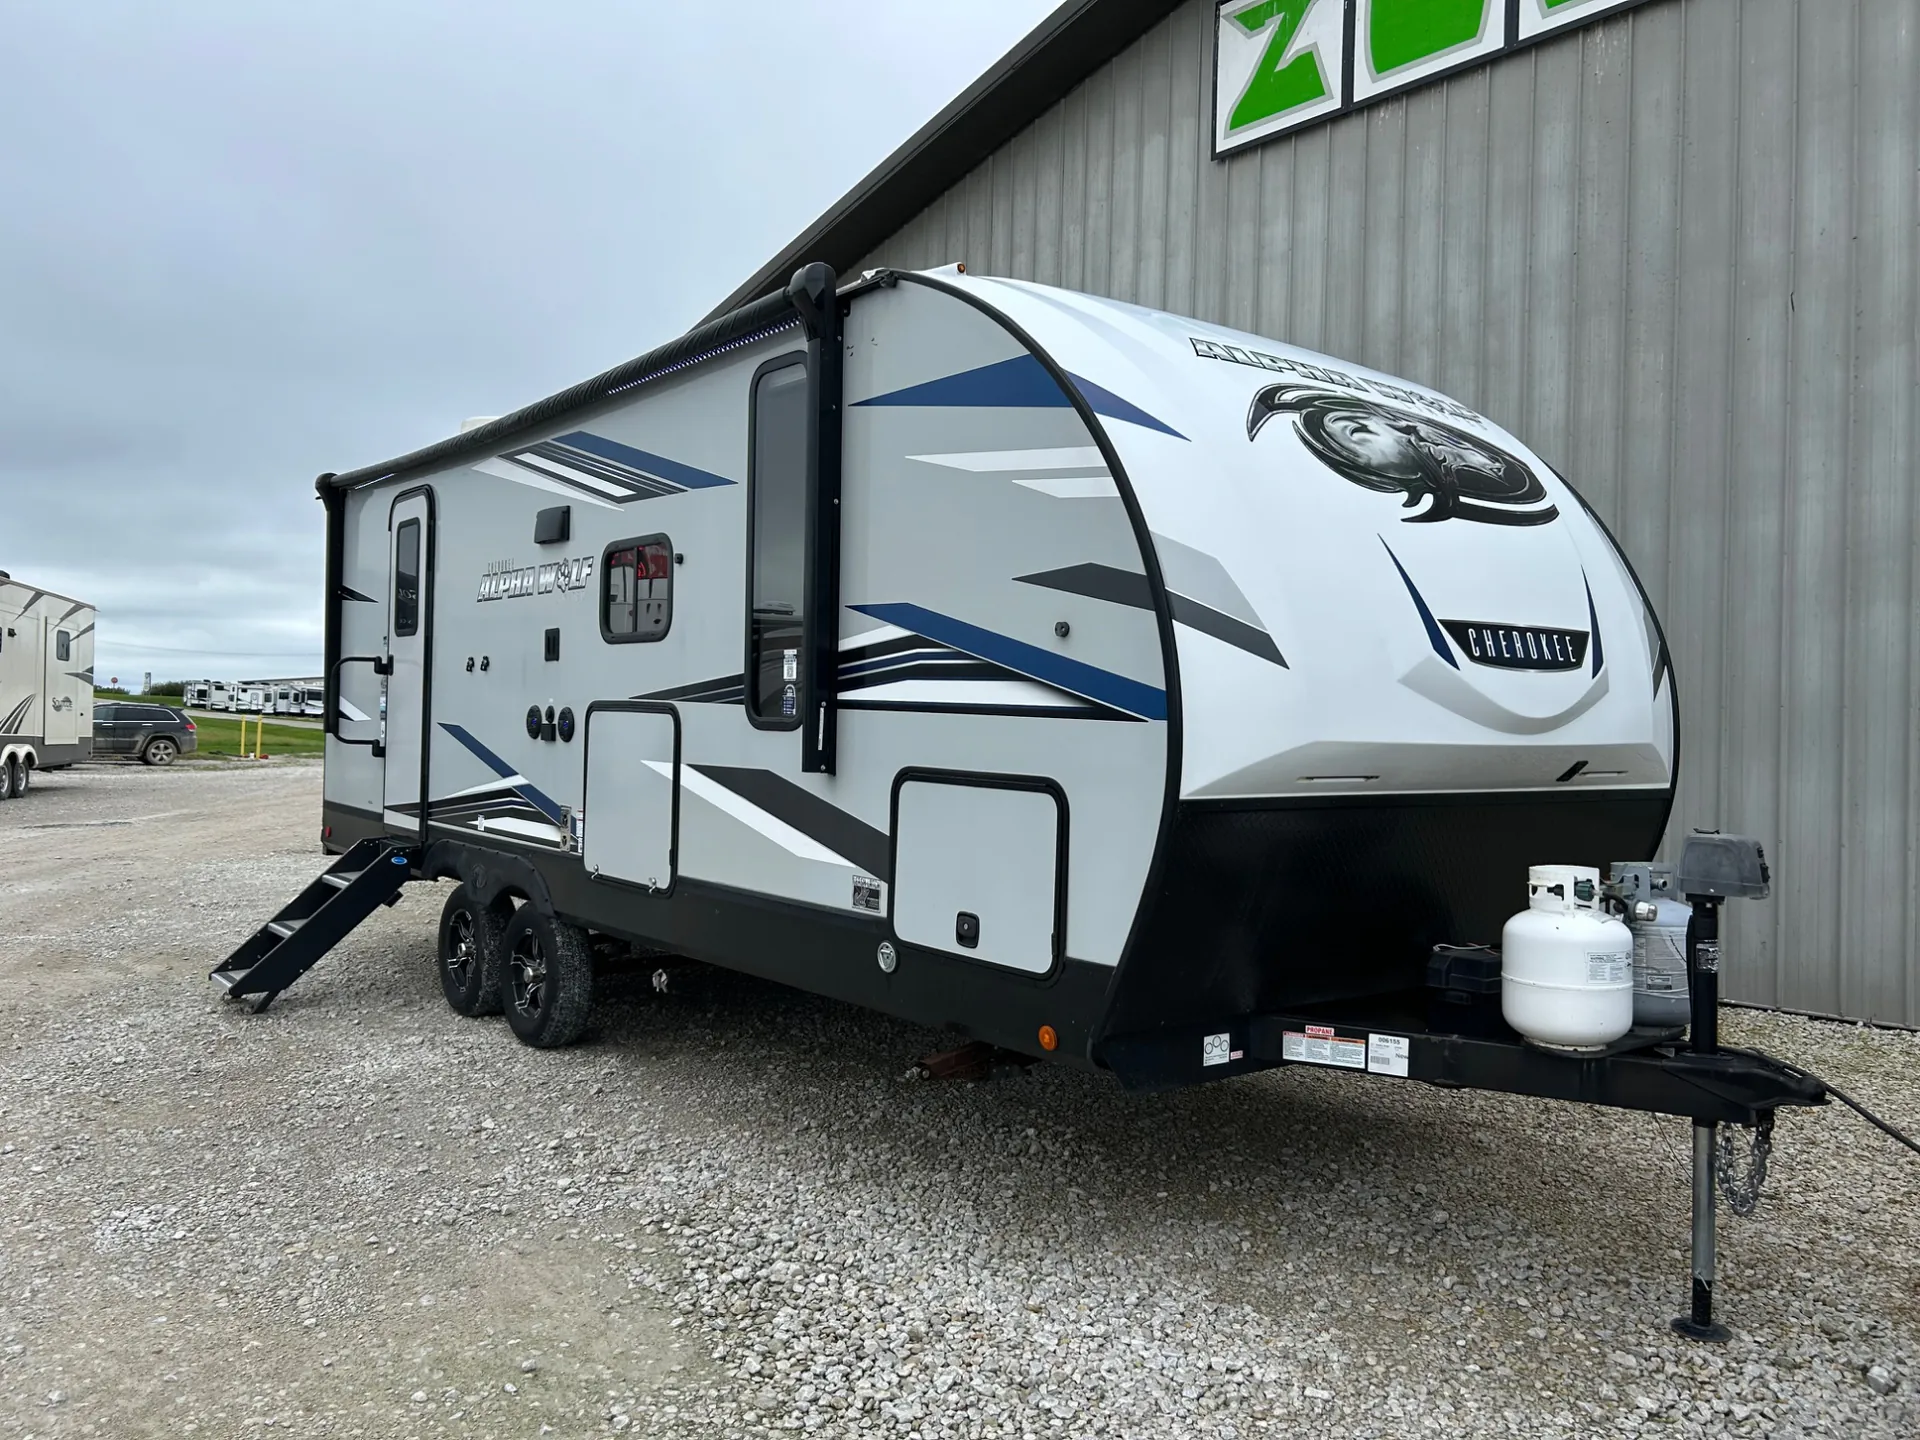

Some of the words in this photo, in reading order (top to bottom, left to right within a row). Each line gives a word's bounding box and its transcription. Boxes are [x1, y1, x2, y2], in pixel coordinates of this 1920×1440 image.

[1189, 337, 1369, 393] ALPHA
[477, 566, 535, 602] ALPHA
[1467, 628, 1577, 662] CHEROKEE
[1306, 1026, 1333, 1035] PROPANE
